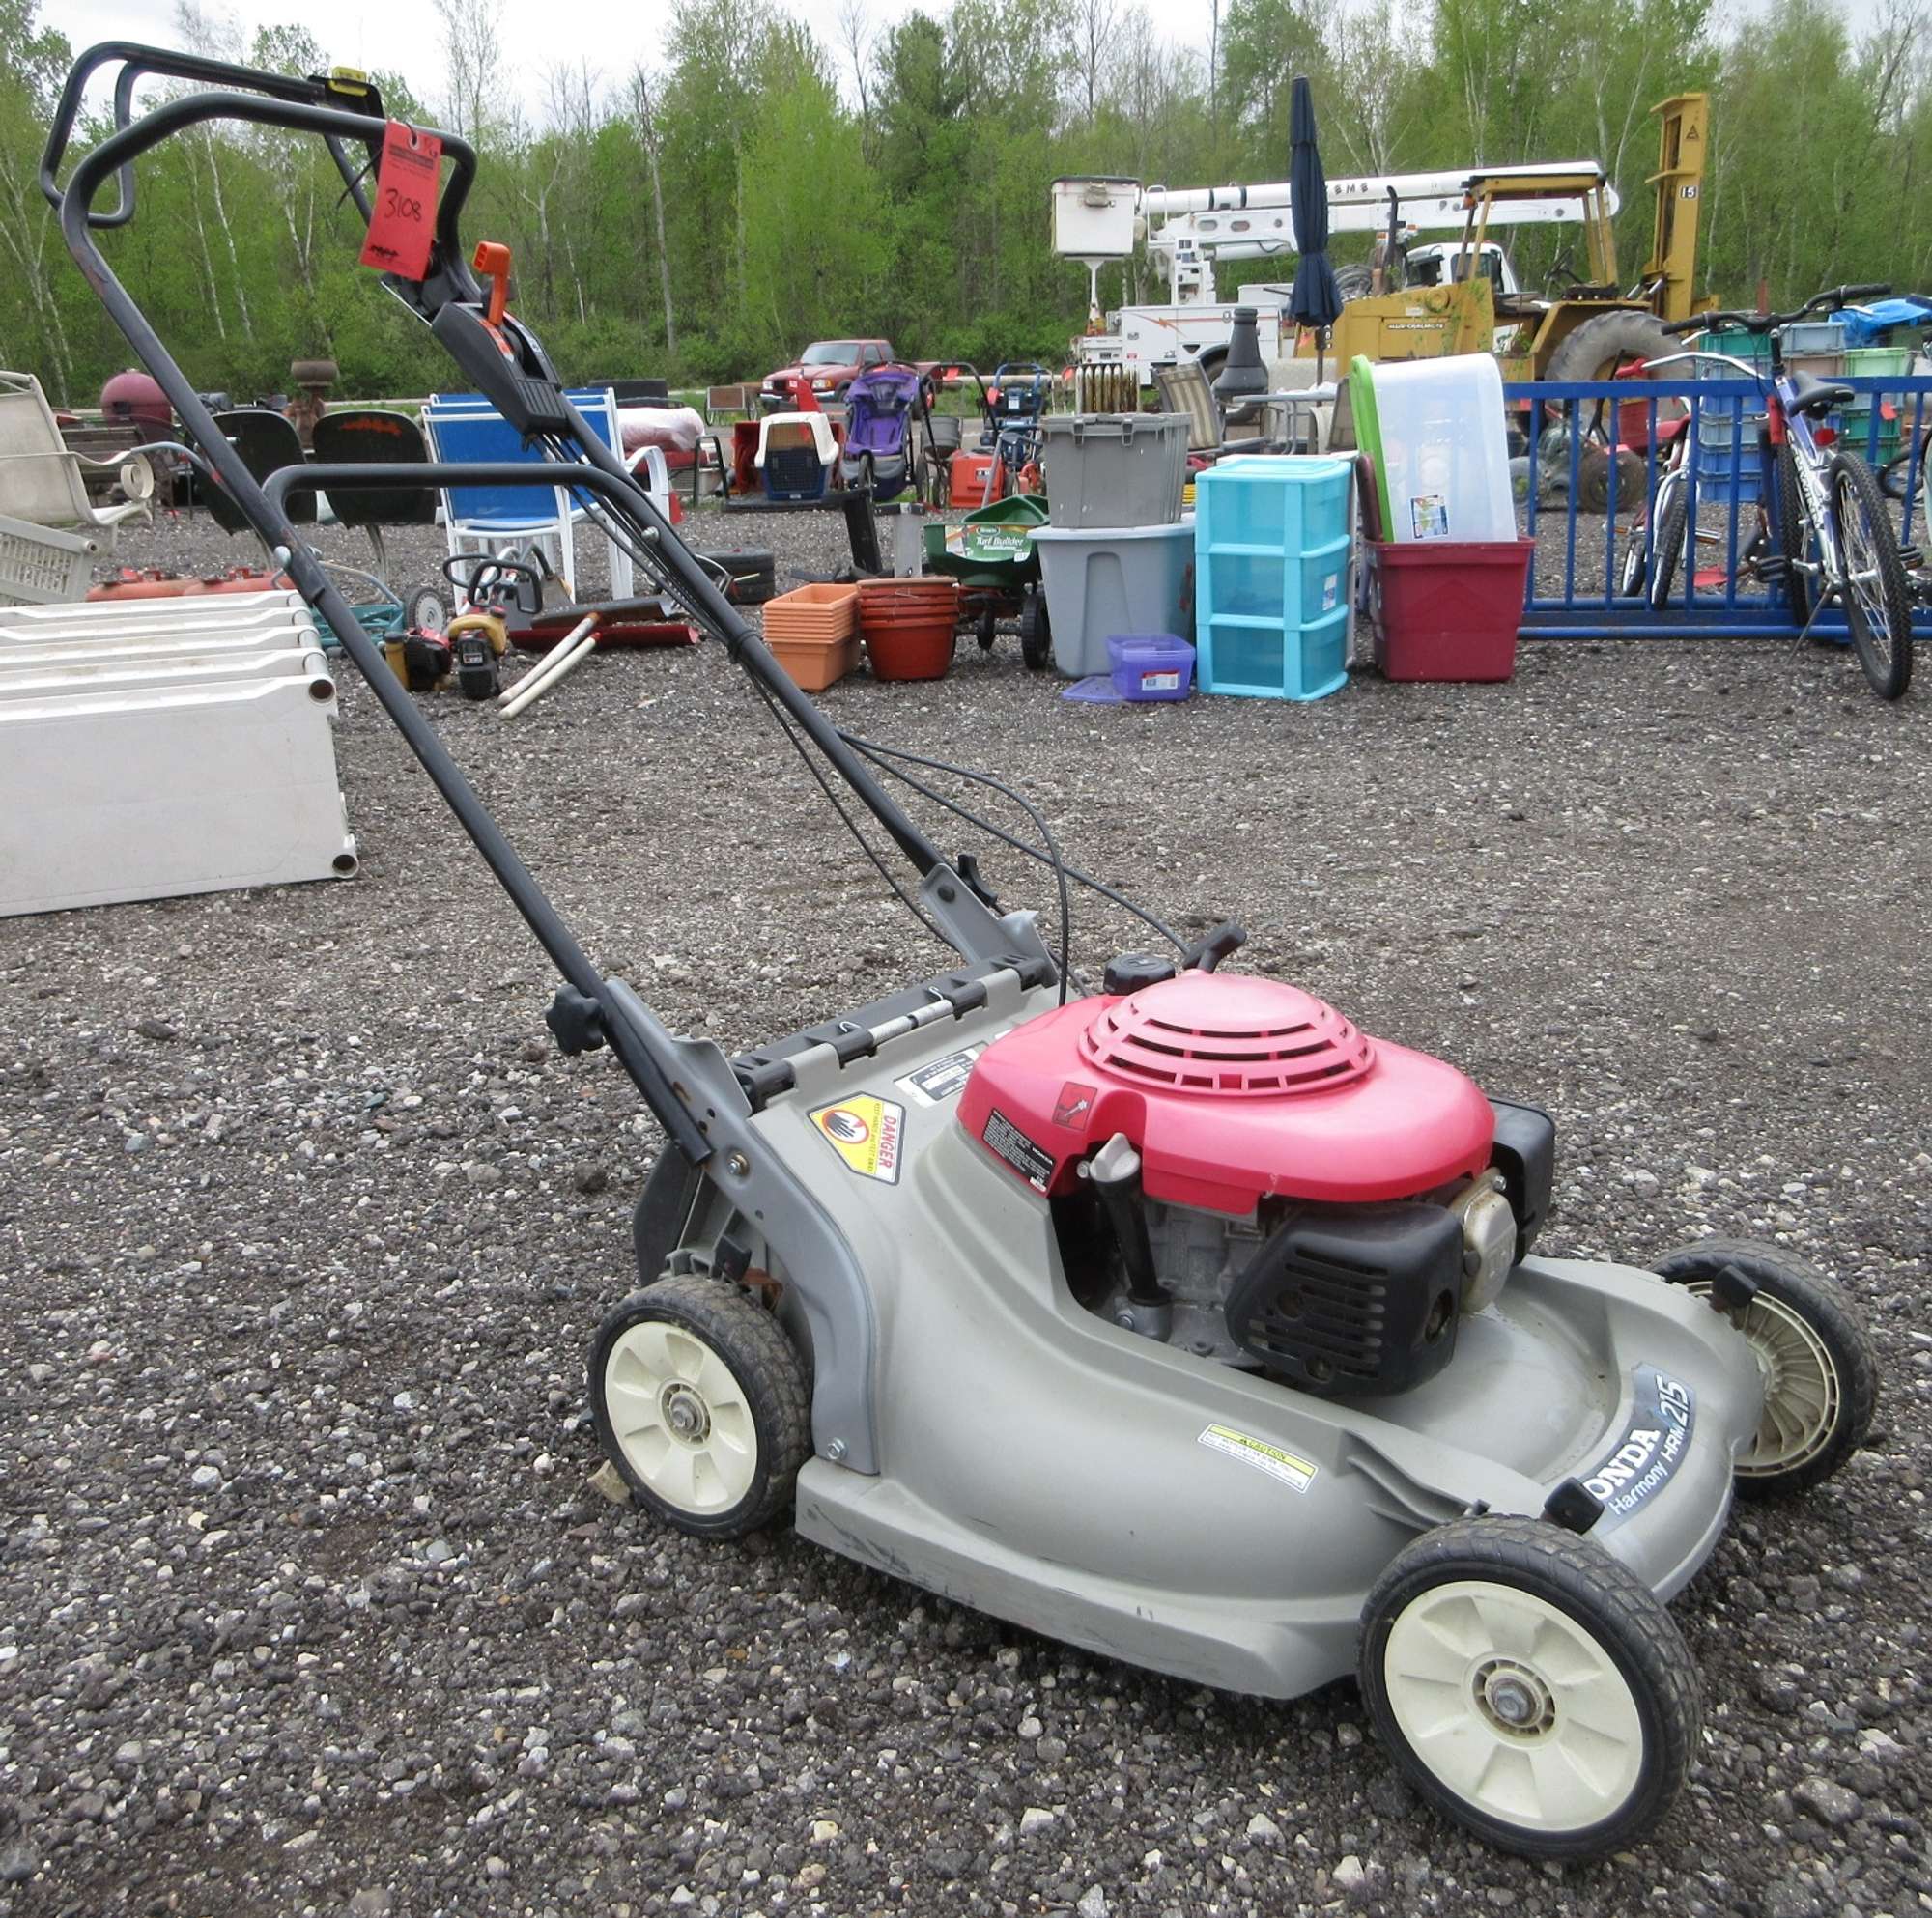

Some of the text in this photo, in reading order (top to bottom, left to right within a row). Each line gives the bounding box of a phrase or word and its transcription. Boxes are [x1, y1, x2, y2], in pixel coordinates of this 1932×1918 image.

[384, 188, 422, 222] 3108
[1681, 186, 1695, 199] 15
[976, 536, 1024, 547] Turf Builder
[878, 1114, 897, 1169] DANGER
[1248, 1441, 1286, 1460] CAUTION
[1582, 1429, 1662, 1500] ONDA
[1608, 1459, 1669, 1515] Harmony
